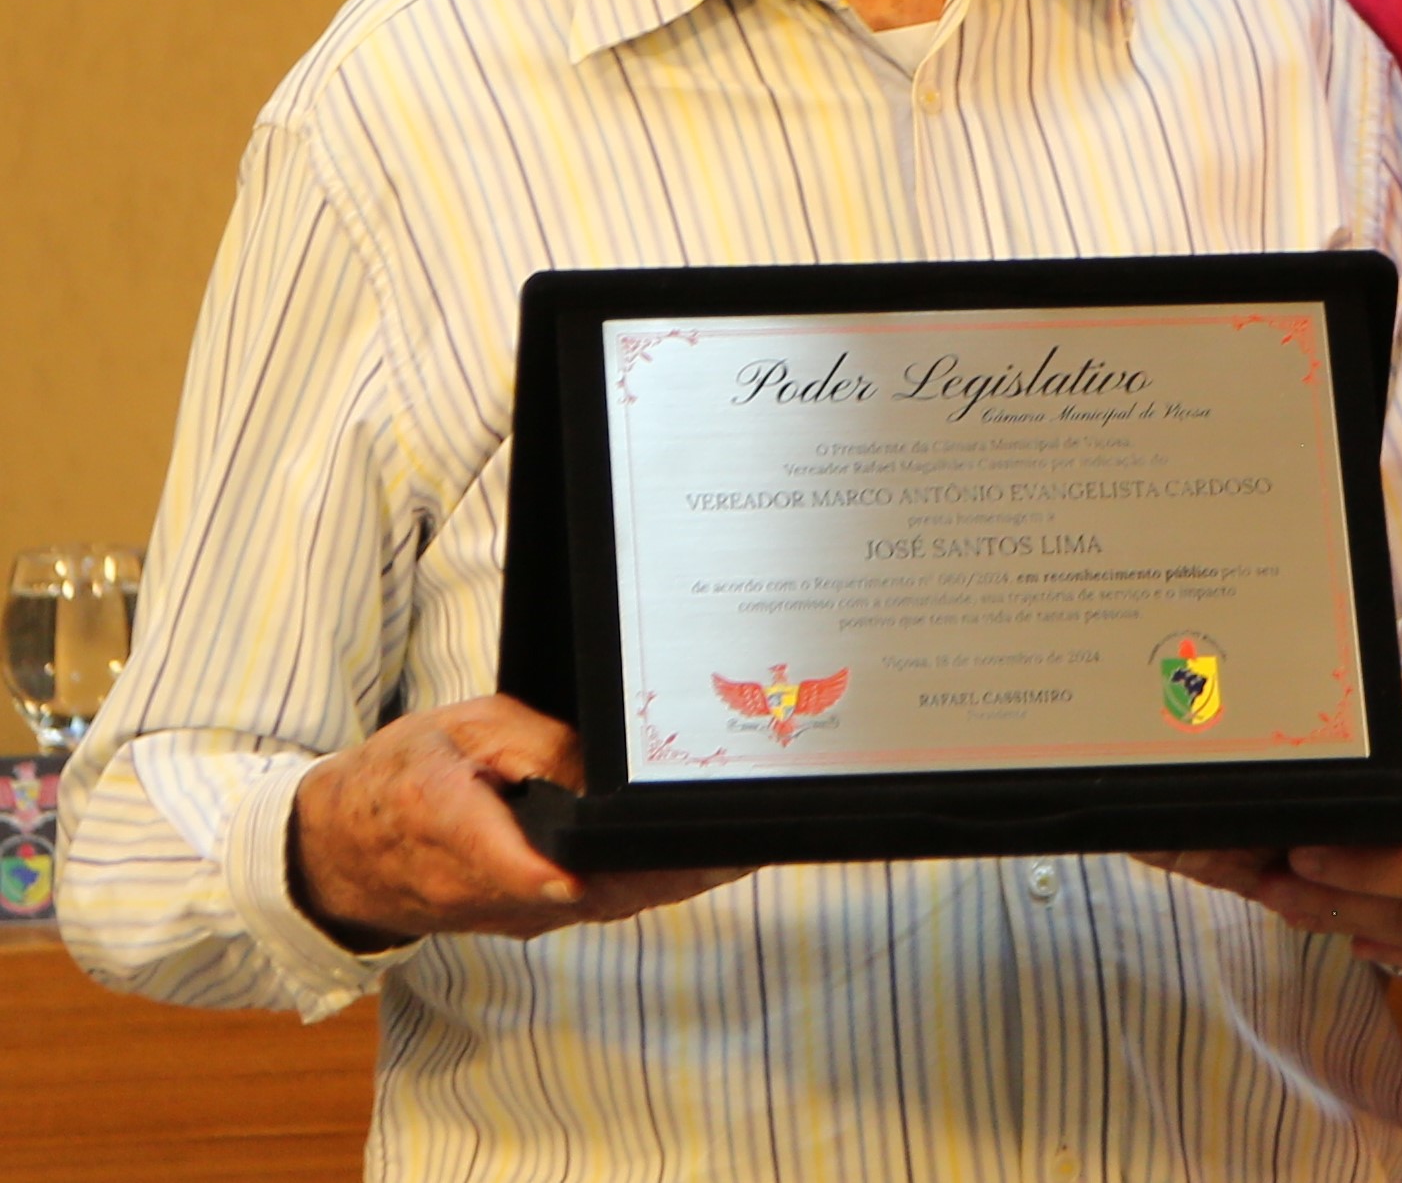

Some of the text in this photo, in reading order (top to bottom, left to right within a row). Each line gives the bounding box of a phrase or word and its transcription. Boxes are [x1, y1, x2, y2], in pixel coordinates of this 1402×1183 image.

[730, 345, 1152, 422] Poder Legislativo
[981, 401, 1211, 428] Câmara Municipal de Viçosa
[815, 443, 828, 456] O
[686, 477, 1273, 511] VEREADOR MARCO ANTÔNIO EVANGELISTA CARDOSO
[865, 534, 1103, 561] JOSÉ SANTOS LIMA
[691, 578, 709, 594] de
[713, 579, 763, 594] acordo
[1017, 573, 1039, 584] em
[1043, 568, 1161, 583] reconhecimento
[1165, 566, 1219, 583] público
[918, 688, 1074, 707] RAFAEL CASSIMIRO
